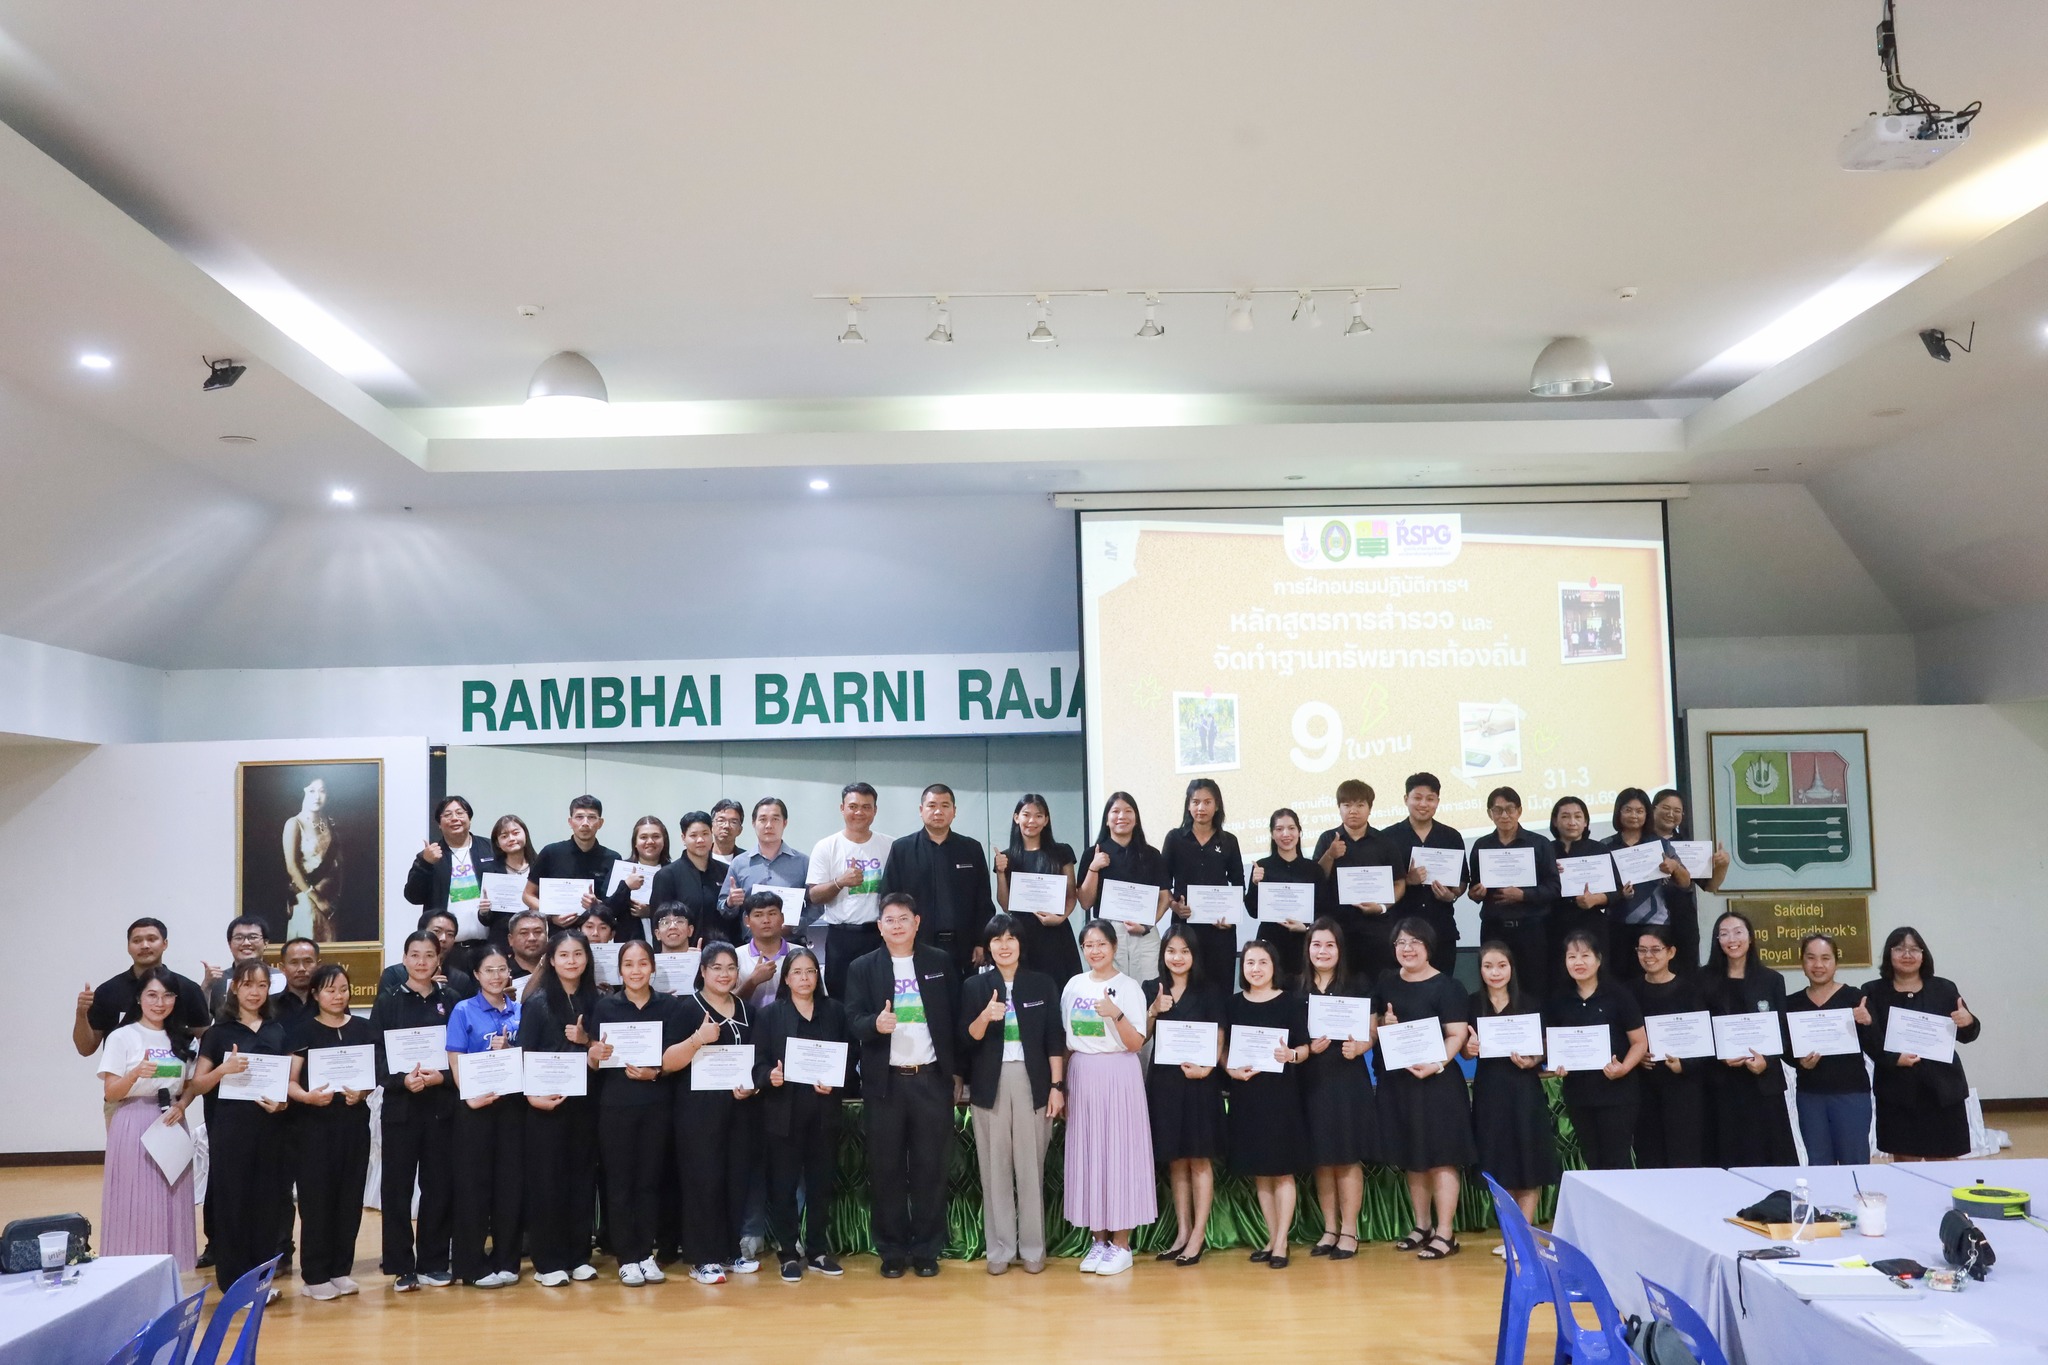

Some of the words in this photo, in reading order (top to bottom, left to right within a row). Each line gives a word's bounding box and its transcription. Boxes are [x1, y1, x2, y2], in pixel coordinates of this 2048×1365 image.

[1396, 521, 1451, 546] RSPG
[1230, 603, 1455, 640] หลักสูตรการสำรวจ
[1462, 616, 1493, 631] และ
[1213, 634, 1527, 676] จัดทำฐานทรัพยากรท้องถิ่น
[462, 675, 722, 732] RAMBHAI
[754, 670, 925, 726] BARNI
[1290, 700, 1343, 773] 9
[1345, 733, 1413, 760] ใบงาน
[1544, 766, 1590, 790] 31-3
[1774, 903, 1824, 918] Sakdidej
[1754, 928, 1769, 942] ng
[1760, 947, 1792, 963] Royal
[1073, 996, 1098, 1010] RSP
